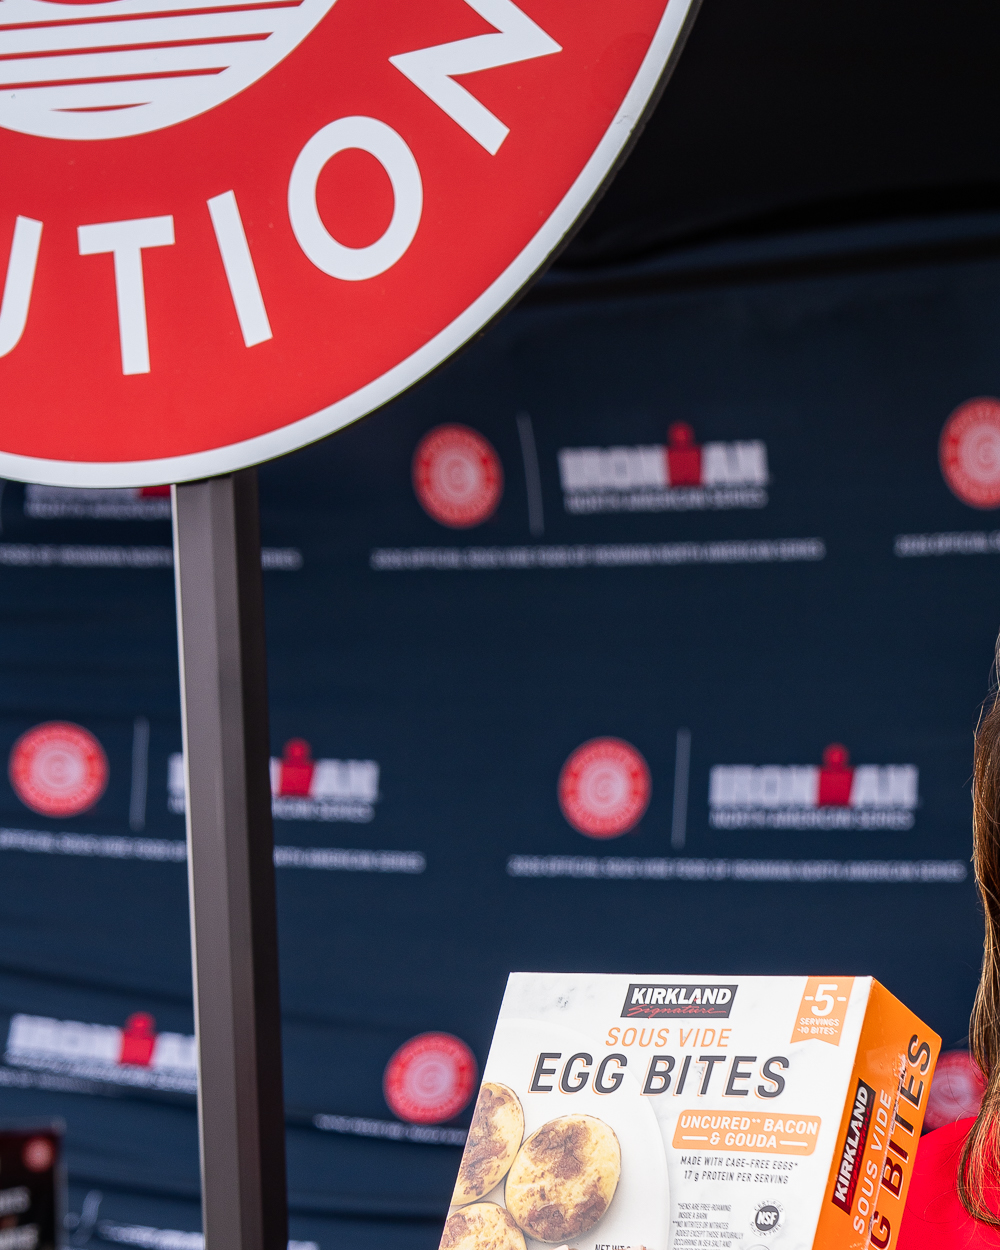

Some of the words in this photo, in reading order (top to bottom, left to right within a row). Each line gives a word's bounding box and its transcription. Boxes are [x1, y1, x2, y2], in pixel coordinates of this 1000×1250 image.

[631, 988, 732, 1004] KIRKLAND
[627, 1004, 727, 1019] Signature
[800, 1018, 840, 1027] SERVINGS
[605, 1027, 670, 1047] SOUS
[679, 1028, 732, 1048] VIDE
[528, 1052, 628, 1096] EGG
[640, 1055, 790, 1100] BITES
[880, 1034, 931, 1201] BITES
[763, 1118, 818, 1135] BACON
[710, 1132, 720, 1145] &
[724, 1132, 777, 1148] GOUDA
[835, 1086, 869, 1203] KIRKLAND
[680, 1156, 702, 1166] MADE
[704, 1157, 724, 1167] WITH
[725, 1158, 771, 1170] CAGE-FREE
[853, 1160, 878, 1234] SOUS
[871, 1089, 892, 1151] VIDE
[684, 1170, 693, 1179] 17
[694, 1173, 699, 1182] g
[701, 1171, 734, 1181] PROTEIN
[737, 1172, 752, 1182] PER
[754, 1173, 789, 1184] SERVING
[757, 1211, 778, 1225] NSF
